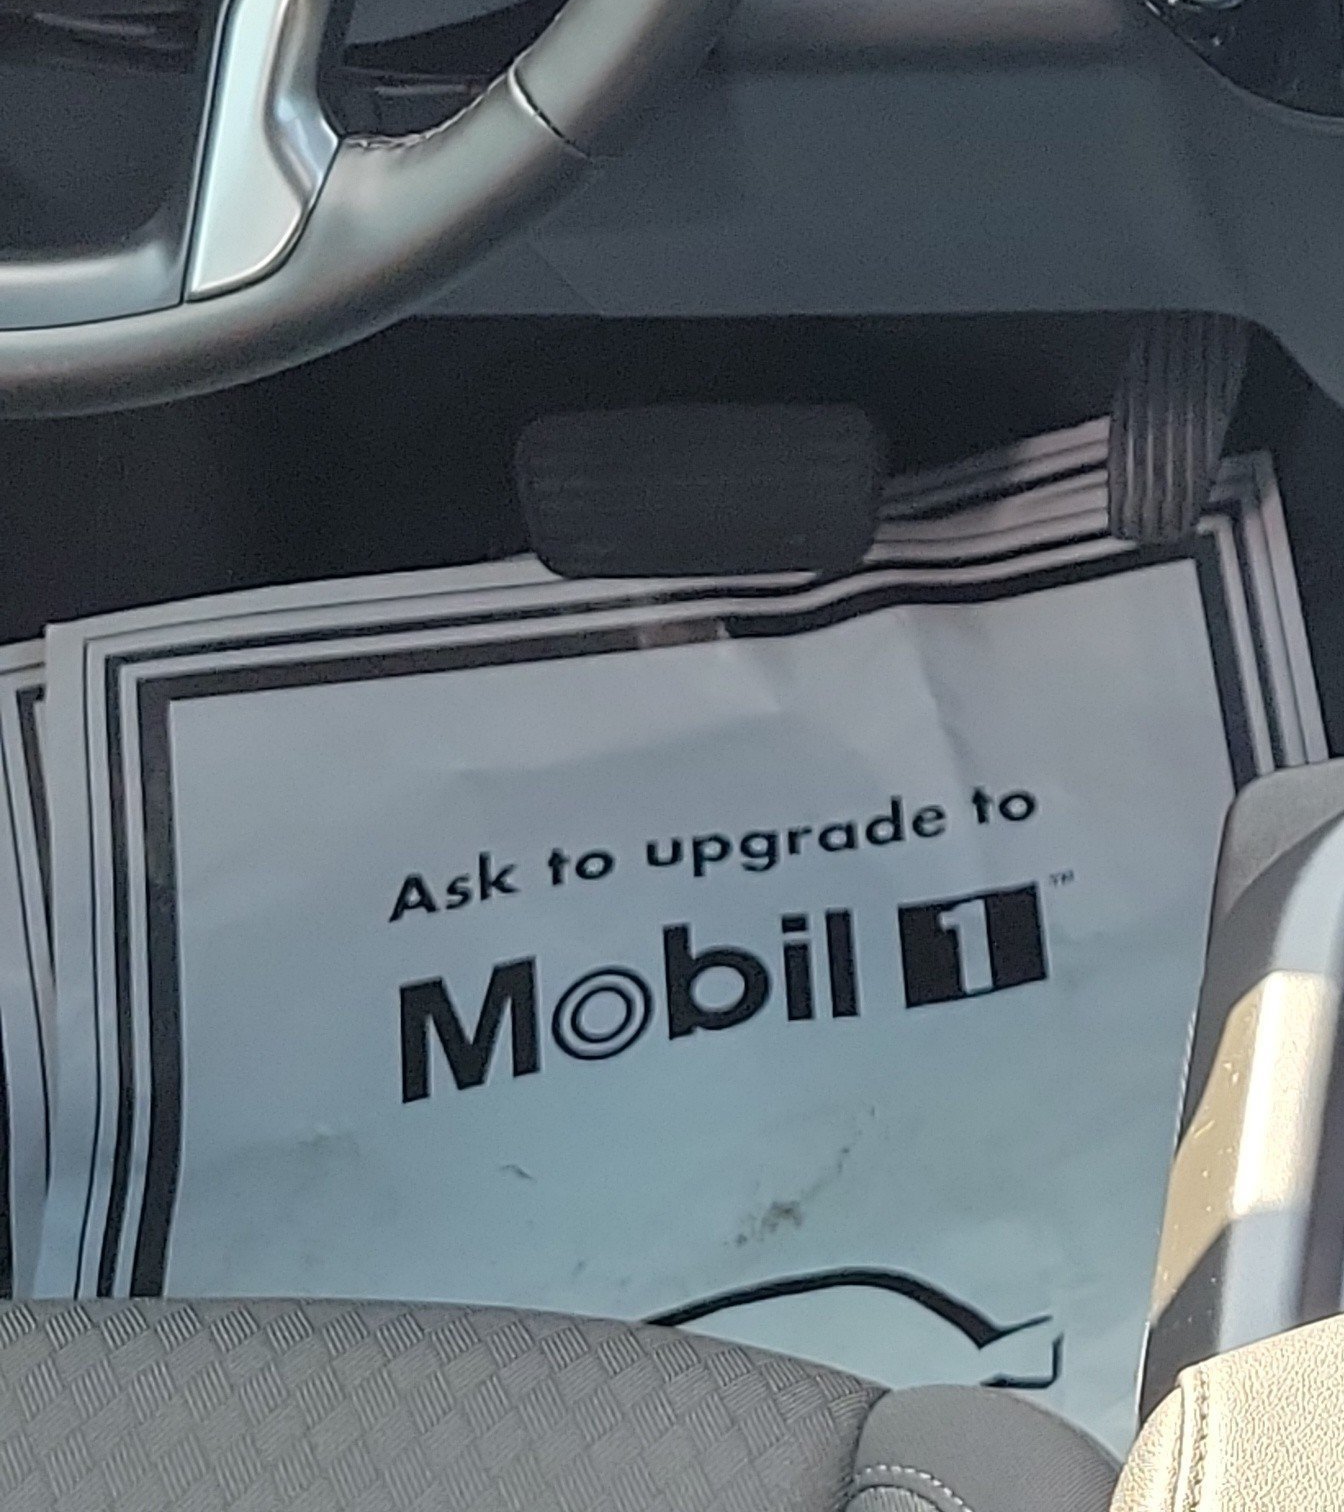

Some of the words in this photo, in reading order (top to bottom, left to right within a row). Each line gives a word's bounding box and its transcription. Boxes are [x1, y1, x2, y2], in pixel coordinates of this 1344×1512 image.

[388, 851, 521, 924] Ask
[546, 847, 616, 889] to
[644, 794, 949, 878] upgrade
[969, 786, 1038, 827] to
[399, 907, 861, 1105] Mobil
